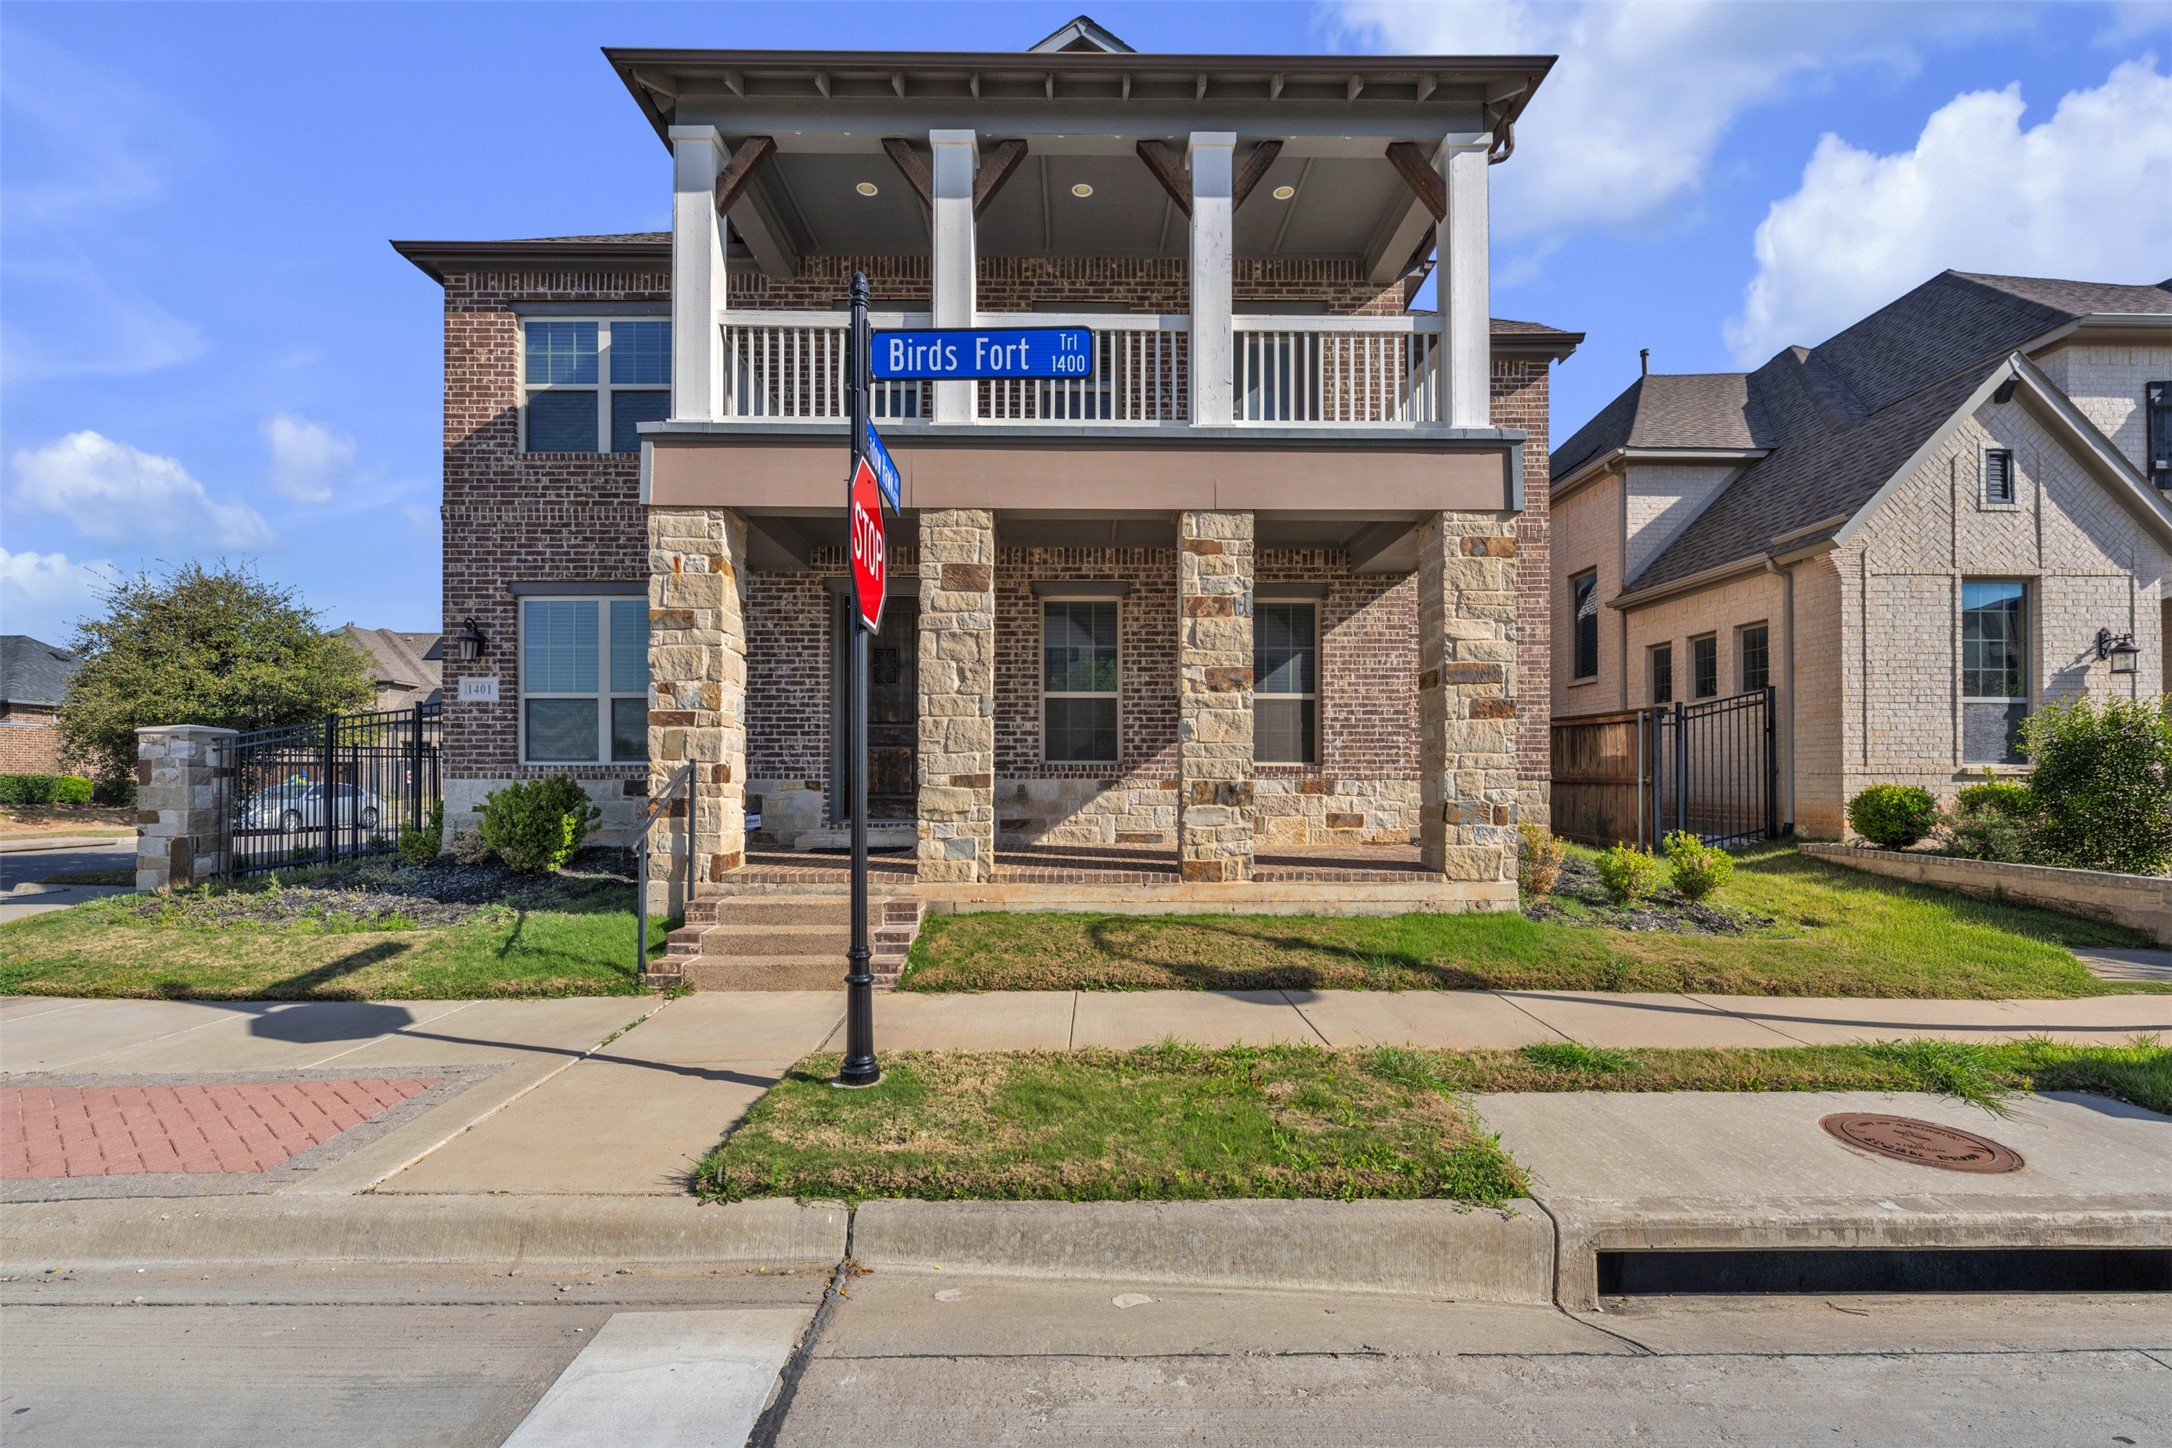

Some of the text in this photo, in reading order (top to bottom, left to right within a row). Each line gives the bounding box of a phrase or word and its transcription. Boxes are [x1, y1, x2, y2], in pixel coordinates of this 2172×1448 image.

[1059, 333, 1078, 351] Trl
[889, 337, 1030, 372] Birds Fort
[1051, 354, 1085, 373] 1400
[854, 500, 883, 581] STOP
[468, 684, 491, 695] 1401
